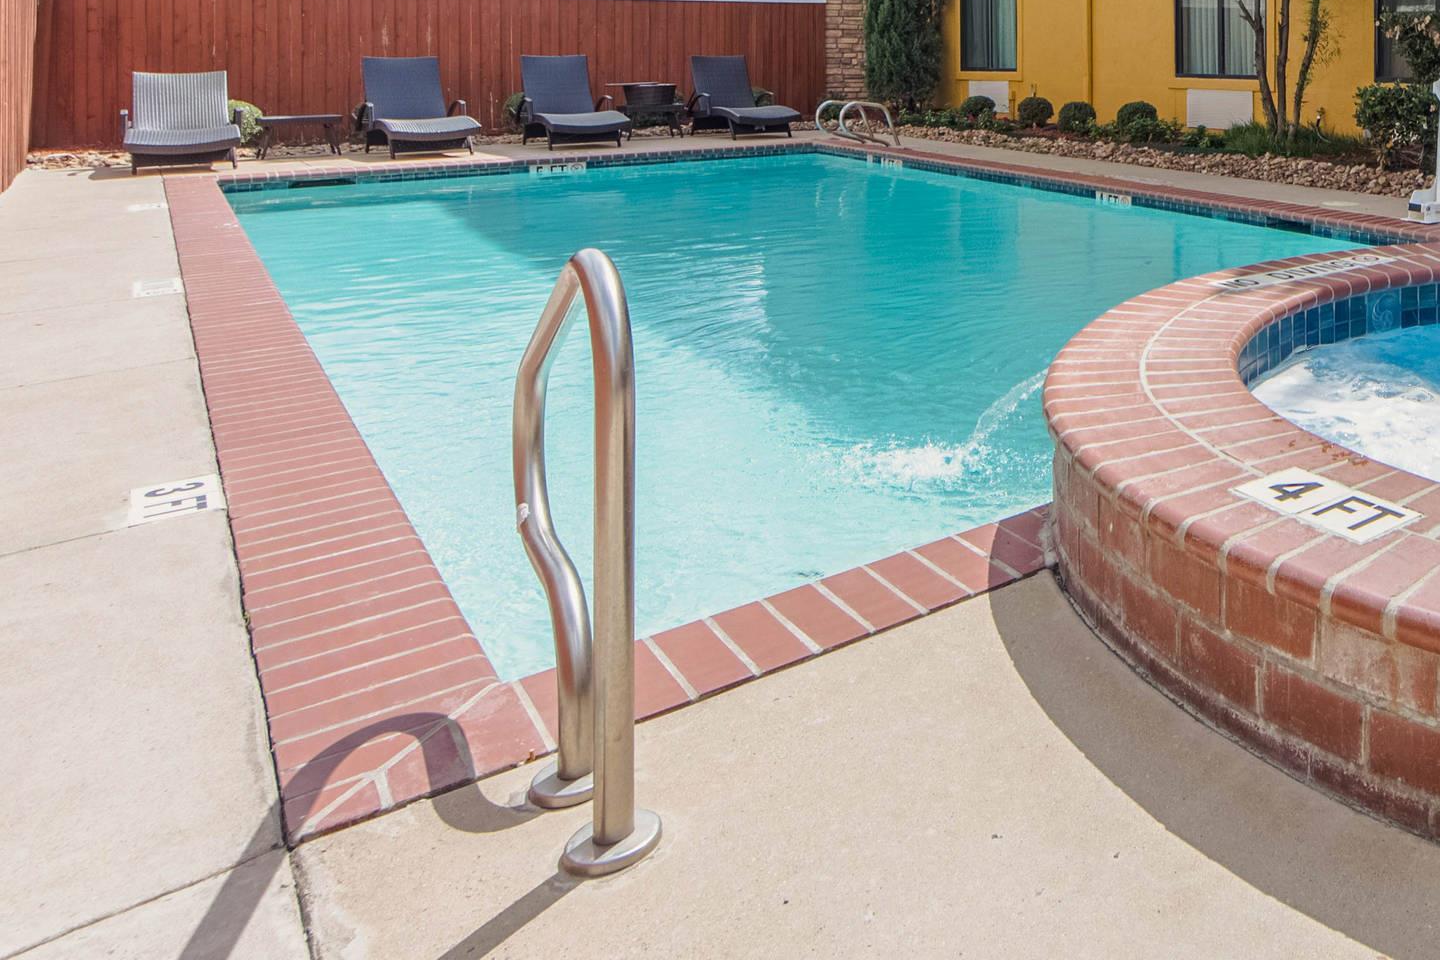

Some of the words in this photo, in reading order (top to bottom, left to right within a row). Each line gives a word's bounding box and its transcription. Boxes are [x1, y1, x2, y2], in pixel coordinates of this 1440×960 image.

[1221, 278, 1260, 289] NO
[1266, 260, 1355, 280] DIVING
[144, 481, 205, 497] 3
[143, 494, 208, 518] FT
[1269, 481, 1324, 502] 4
[1311, 495, 1406, 531] FT
